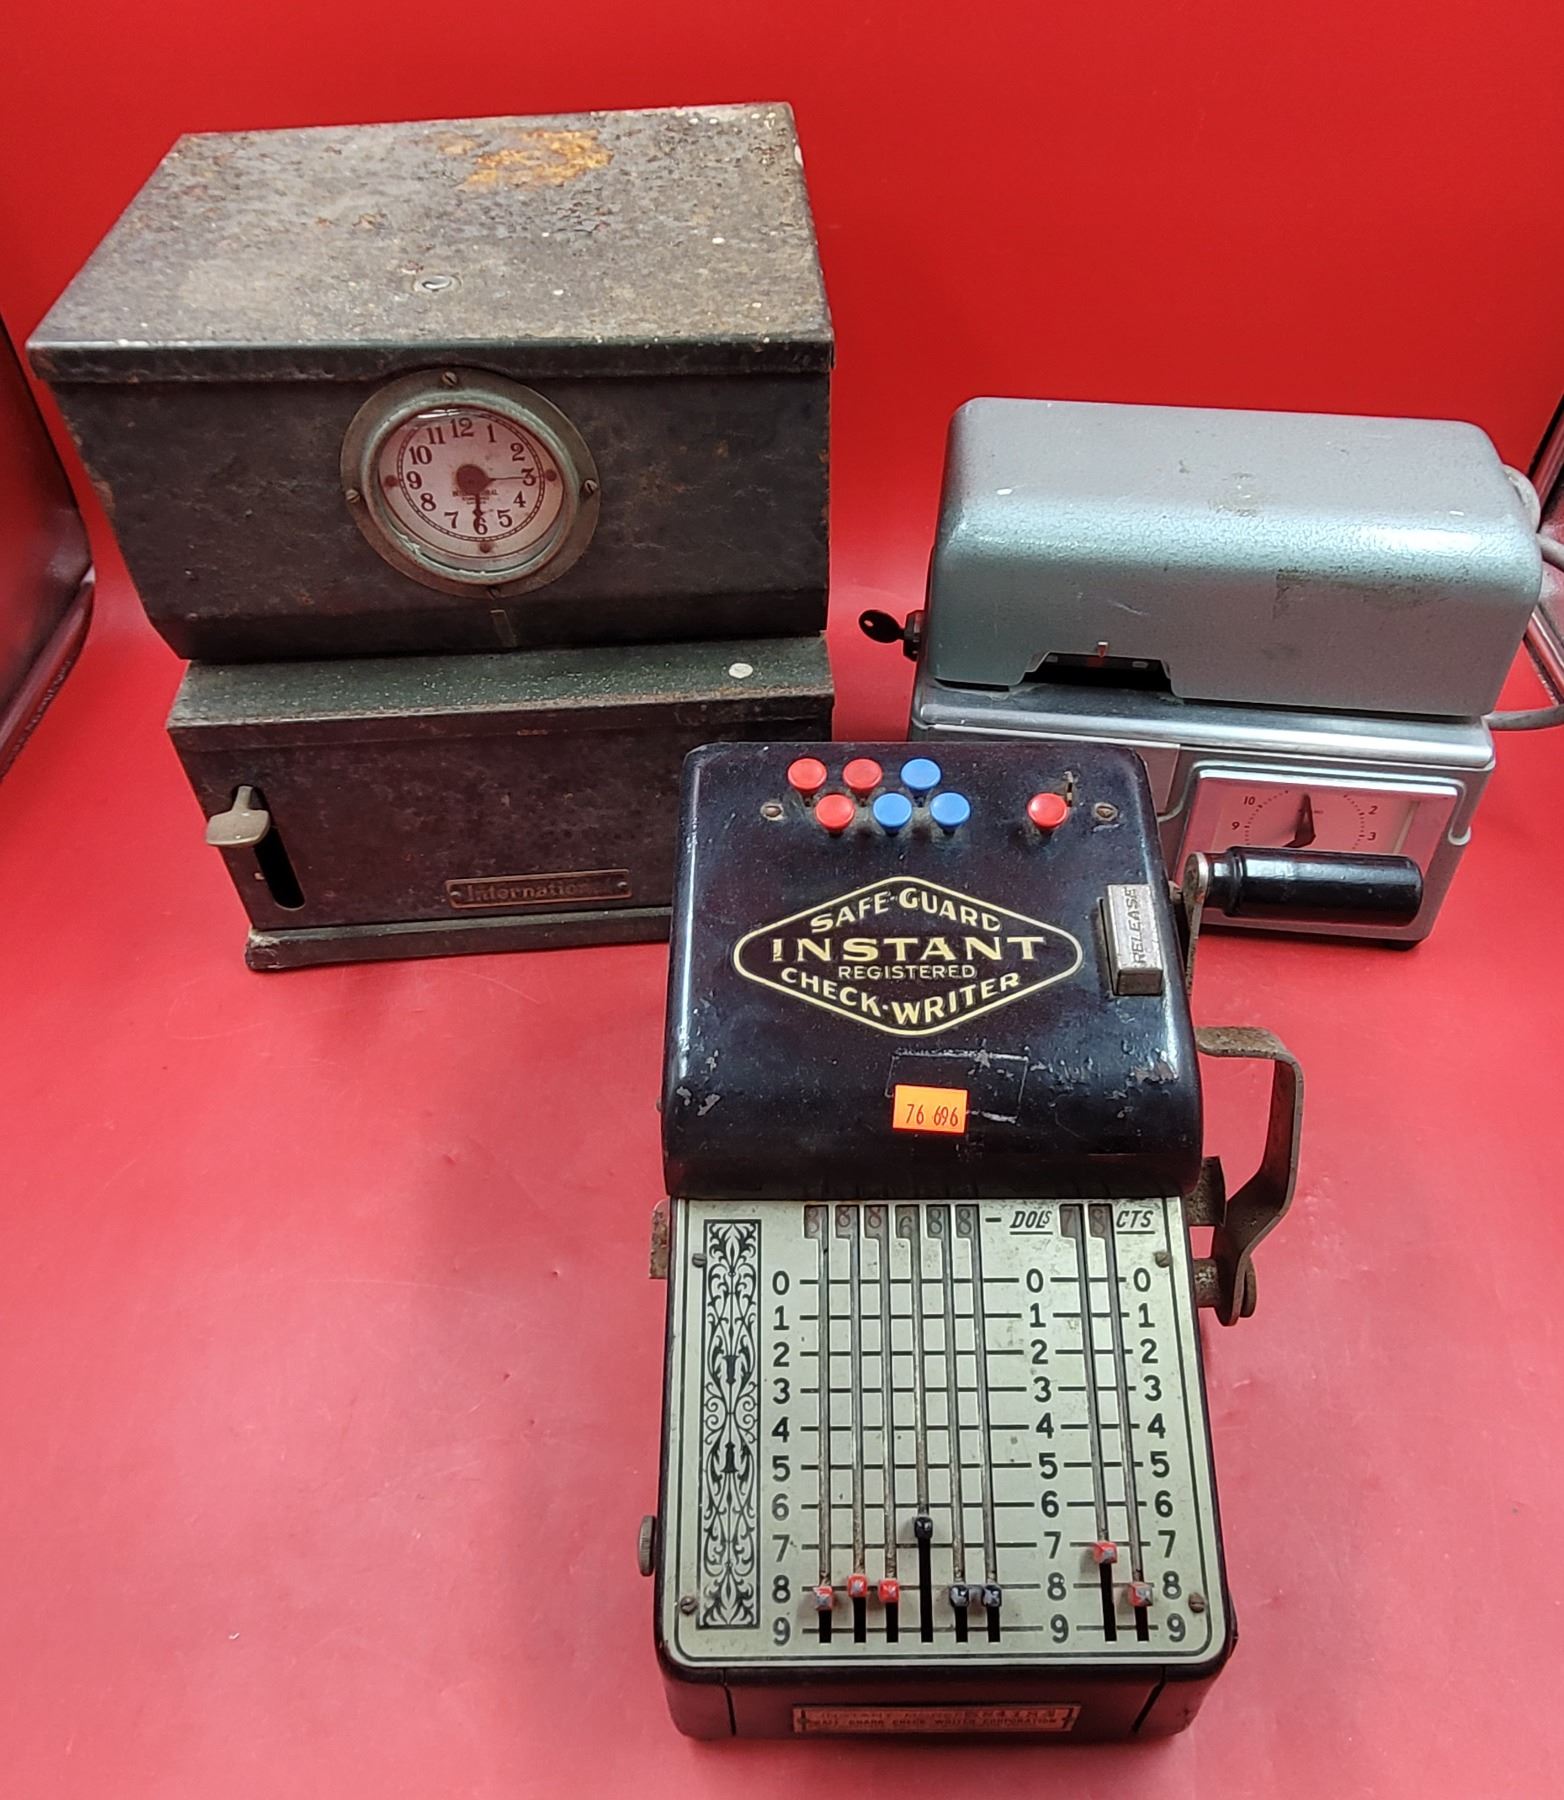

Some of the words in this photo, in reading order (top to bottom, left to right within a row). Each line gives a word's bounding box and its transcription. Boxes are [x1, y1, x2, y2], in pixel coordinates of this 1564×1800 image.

[427, 427, 446, 444] 11
[451, 417, 474, 438] 12
[487, 423, 497, 443] 1
[409, 445, 432, 464] 10
[510, 443, 524, 461] 2
[406, 471, 422, 489] 9
[521, 468, 536, 486] 3
[420, 493, 437, 511] 8
[513, 491, 526, 507] 4
[444, 511, 459, 529] 7
[473, 516, 488, 534] 6
[497, 509, 512, 527] 5
[1243, 796, 1256, 806] 10
[1369, 805, 1378, 815] 2
[1232, 821, 1240, 831] 9
[1368, 832, 1376, 841] 3
[1124, 886, 1146, 964] RELEASE
[772, 936, 1045, 962] INSTANT
[838, 964, 978, 980] REGISTERED
[906, 1104, 924, 1125] 76
[934, 1105, 958, 1127] 696
[900, 1216, 912, 1237] 6
[929, 1208, 942, 1234] 8
[959, 1208, 972, 1235] 8
[1062, 1208, 1073, 1234] 7
[1116, 1210, 1154, 1228] CTS
[772, 1271, 790, 1295] 0
[1026, 1268, 1044, 1293] 0
[1133, 1268, 1151, 1292] 0
[773, 1305, 790, 1330] 1
[1030, 1303, 1046, 1327] 1
[1138, 1303, 1155, 1328] 1
[773, 1342, 790, 1367] 2
[1031, 1339, 1048, 1364] 2
[1140, 1338, 1158, 1364] 2
[772, 1378, 790, 1404] 3
[1033, 1376, 1051, 1402] 3
[1143, 1375, 1162, 1401] 3
[771, 1416, 790, 1443] 4
[1036, 1412, 1054, 1439] 4
[1147, 1413, 1166, 1439] 4
[772, 1455, 790, 1482] 5
[1039, 1453, 1058, 1480] 5
[1150, 1451, 1170, 1478] 5
[772, 1493, 789, 1521] 6
[1041, 1490, 1059, 1518] 6
[1155, 1490, 1173, 1518] 6
[772, 1534, 790, 1562] 7
[1044, 1531, 1061, 1559] 7
[1158, 1530, 1176, 1558] 7
[772, 1575, 791, 1603] 8
[1047, 1572, 1066, 1600] 8
[1162, 1571, 1182, 1600] 8
[772, 1617, 790, 1646] 9
[1050, 1614, 1069, 1643] 9
[1166, 1613, 1186, 1642] 9
